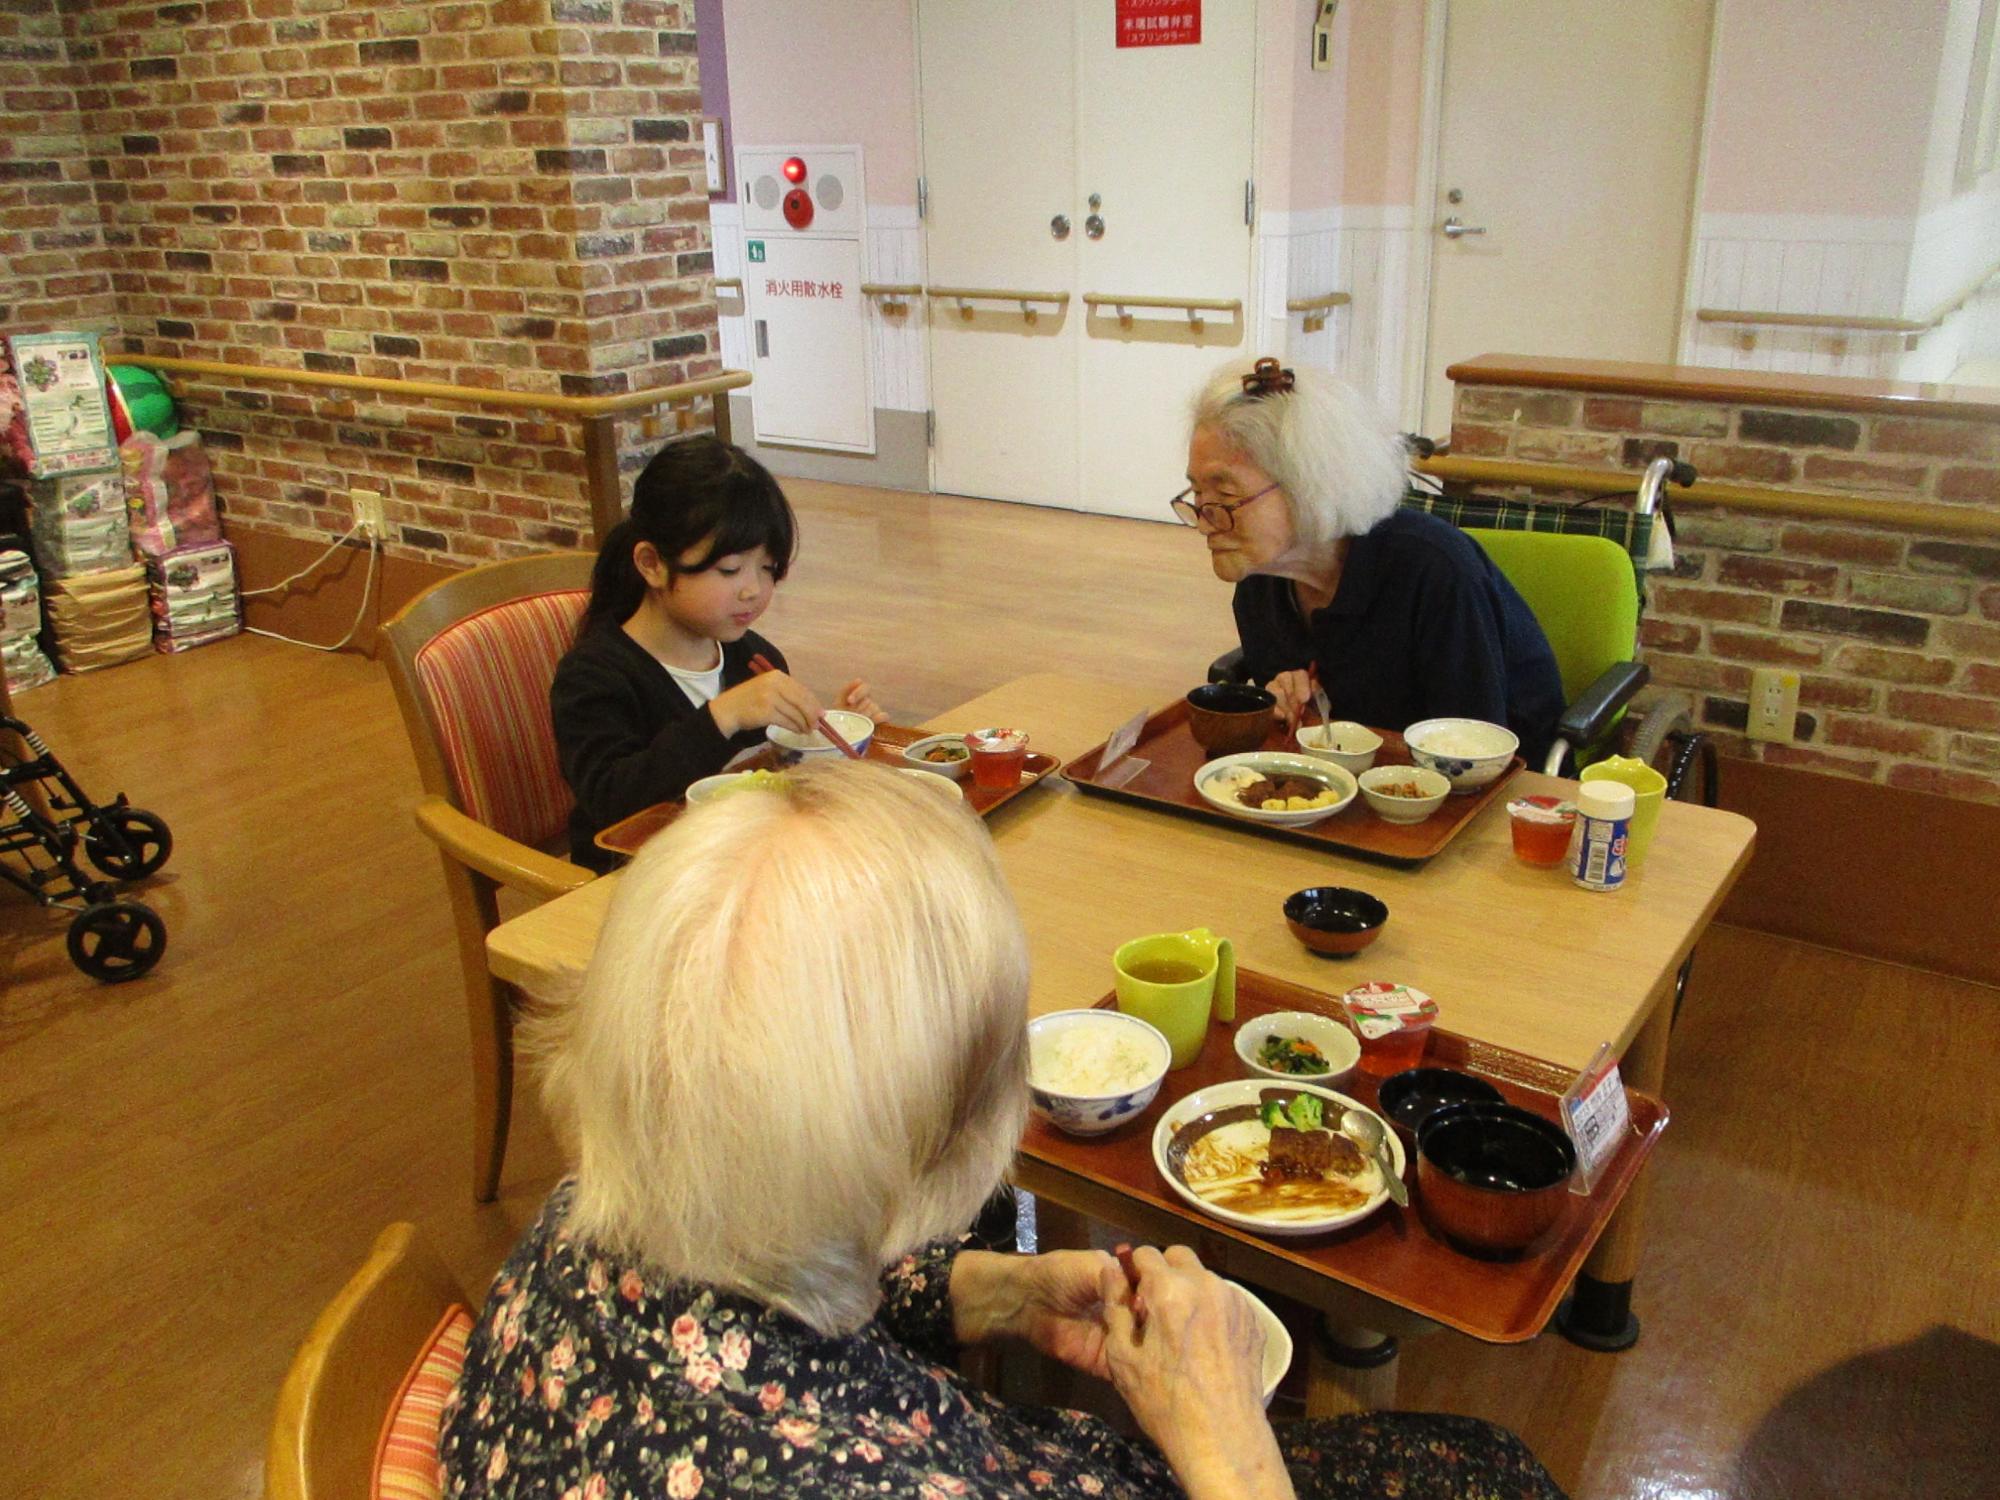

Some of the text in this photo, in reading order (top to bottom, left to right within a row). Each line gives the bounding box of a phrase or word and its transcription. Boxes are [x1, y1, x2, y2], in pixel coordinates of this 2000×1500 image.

[765, 279, 843, 299] 消火用散水栓
